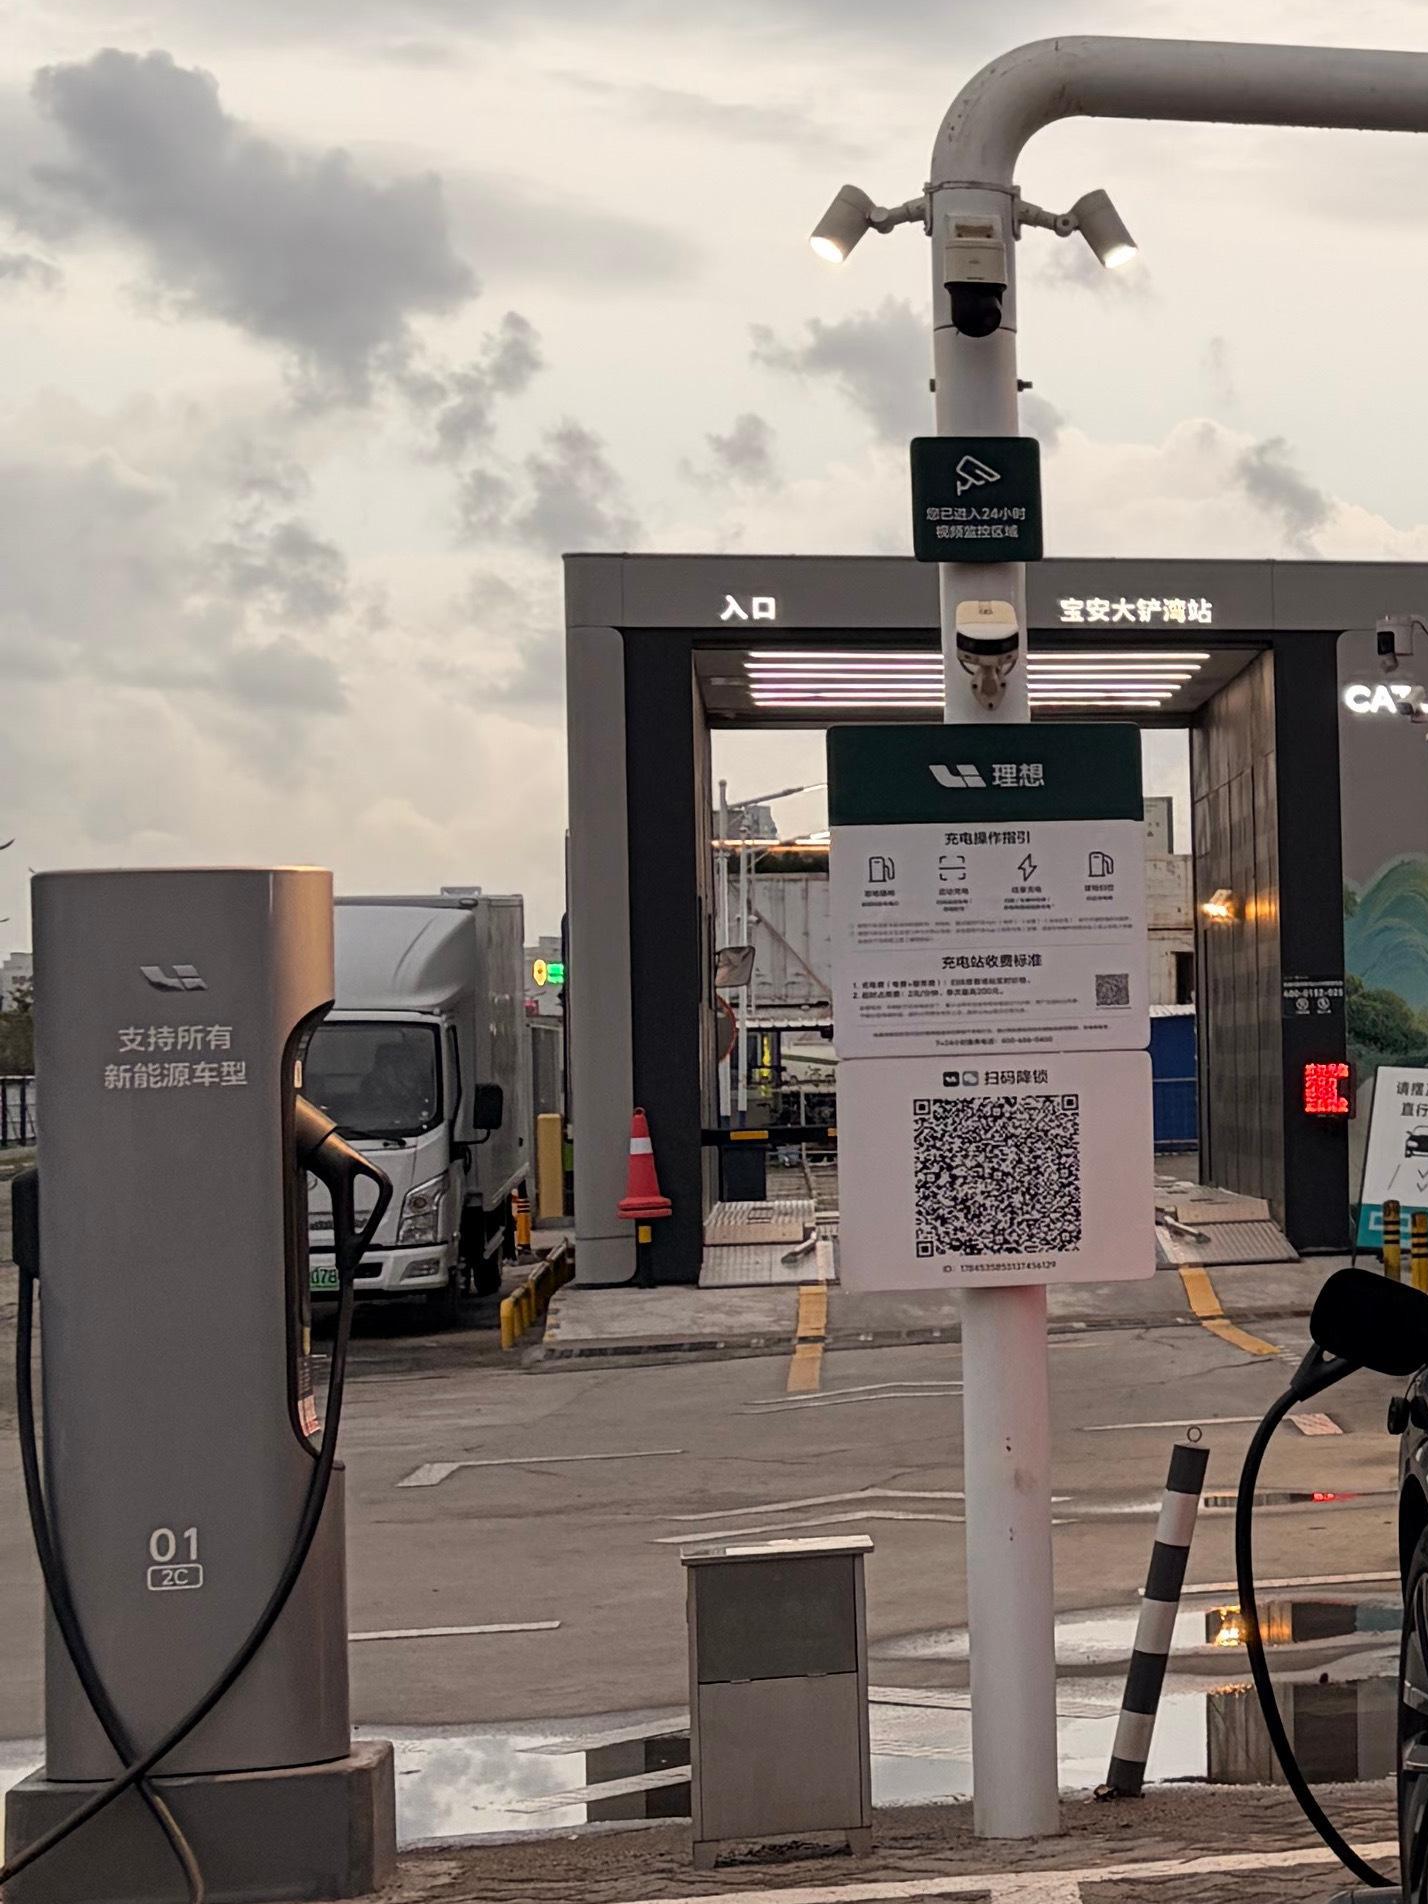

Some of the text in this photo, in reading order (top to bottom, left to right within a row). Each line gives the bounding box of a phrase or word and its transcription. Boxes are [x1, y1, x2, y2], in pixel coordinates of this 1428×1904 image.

[925, 507, 1026, 521] 您已进入24小时
[935, 525, 1019, 538] 视频监控区域
[720, 596, 777, 621] 入口
[1059, 598, 1213, 624] 宝安大铲湾站
[992, 763, 1045, 787] 理想
[944, 831, 1031, 846] 充电操作指引
[941, 953, 1043, 969] 充电站收费标准
[118, 1024, 233, 1053] 支持所有
[103, 1060, 248, 1090] 新能源车型
[983, 1069, 1049, 1086] 扫码降锁
[148, 1527, 199, 1563] 01
[161, 1567, 189, 1587] 2C
